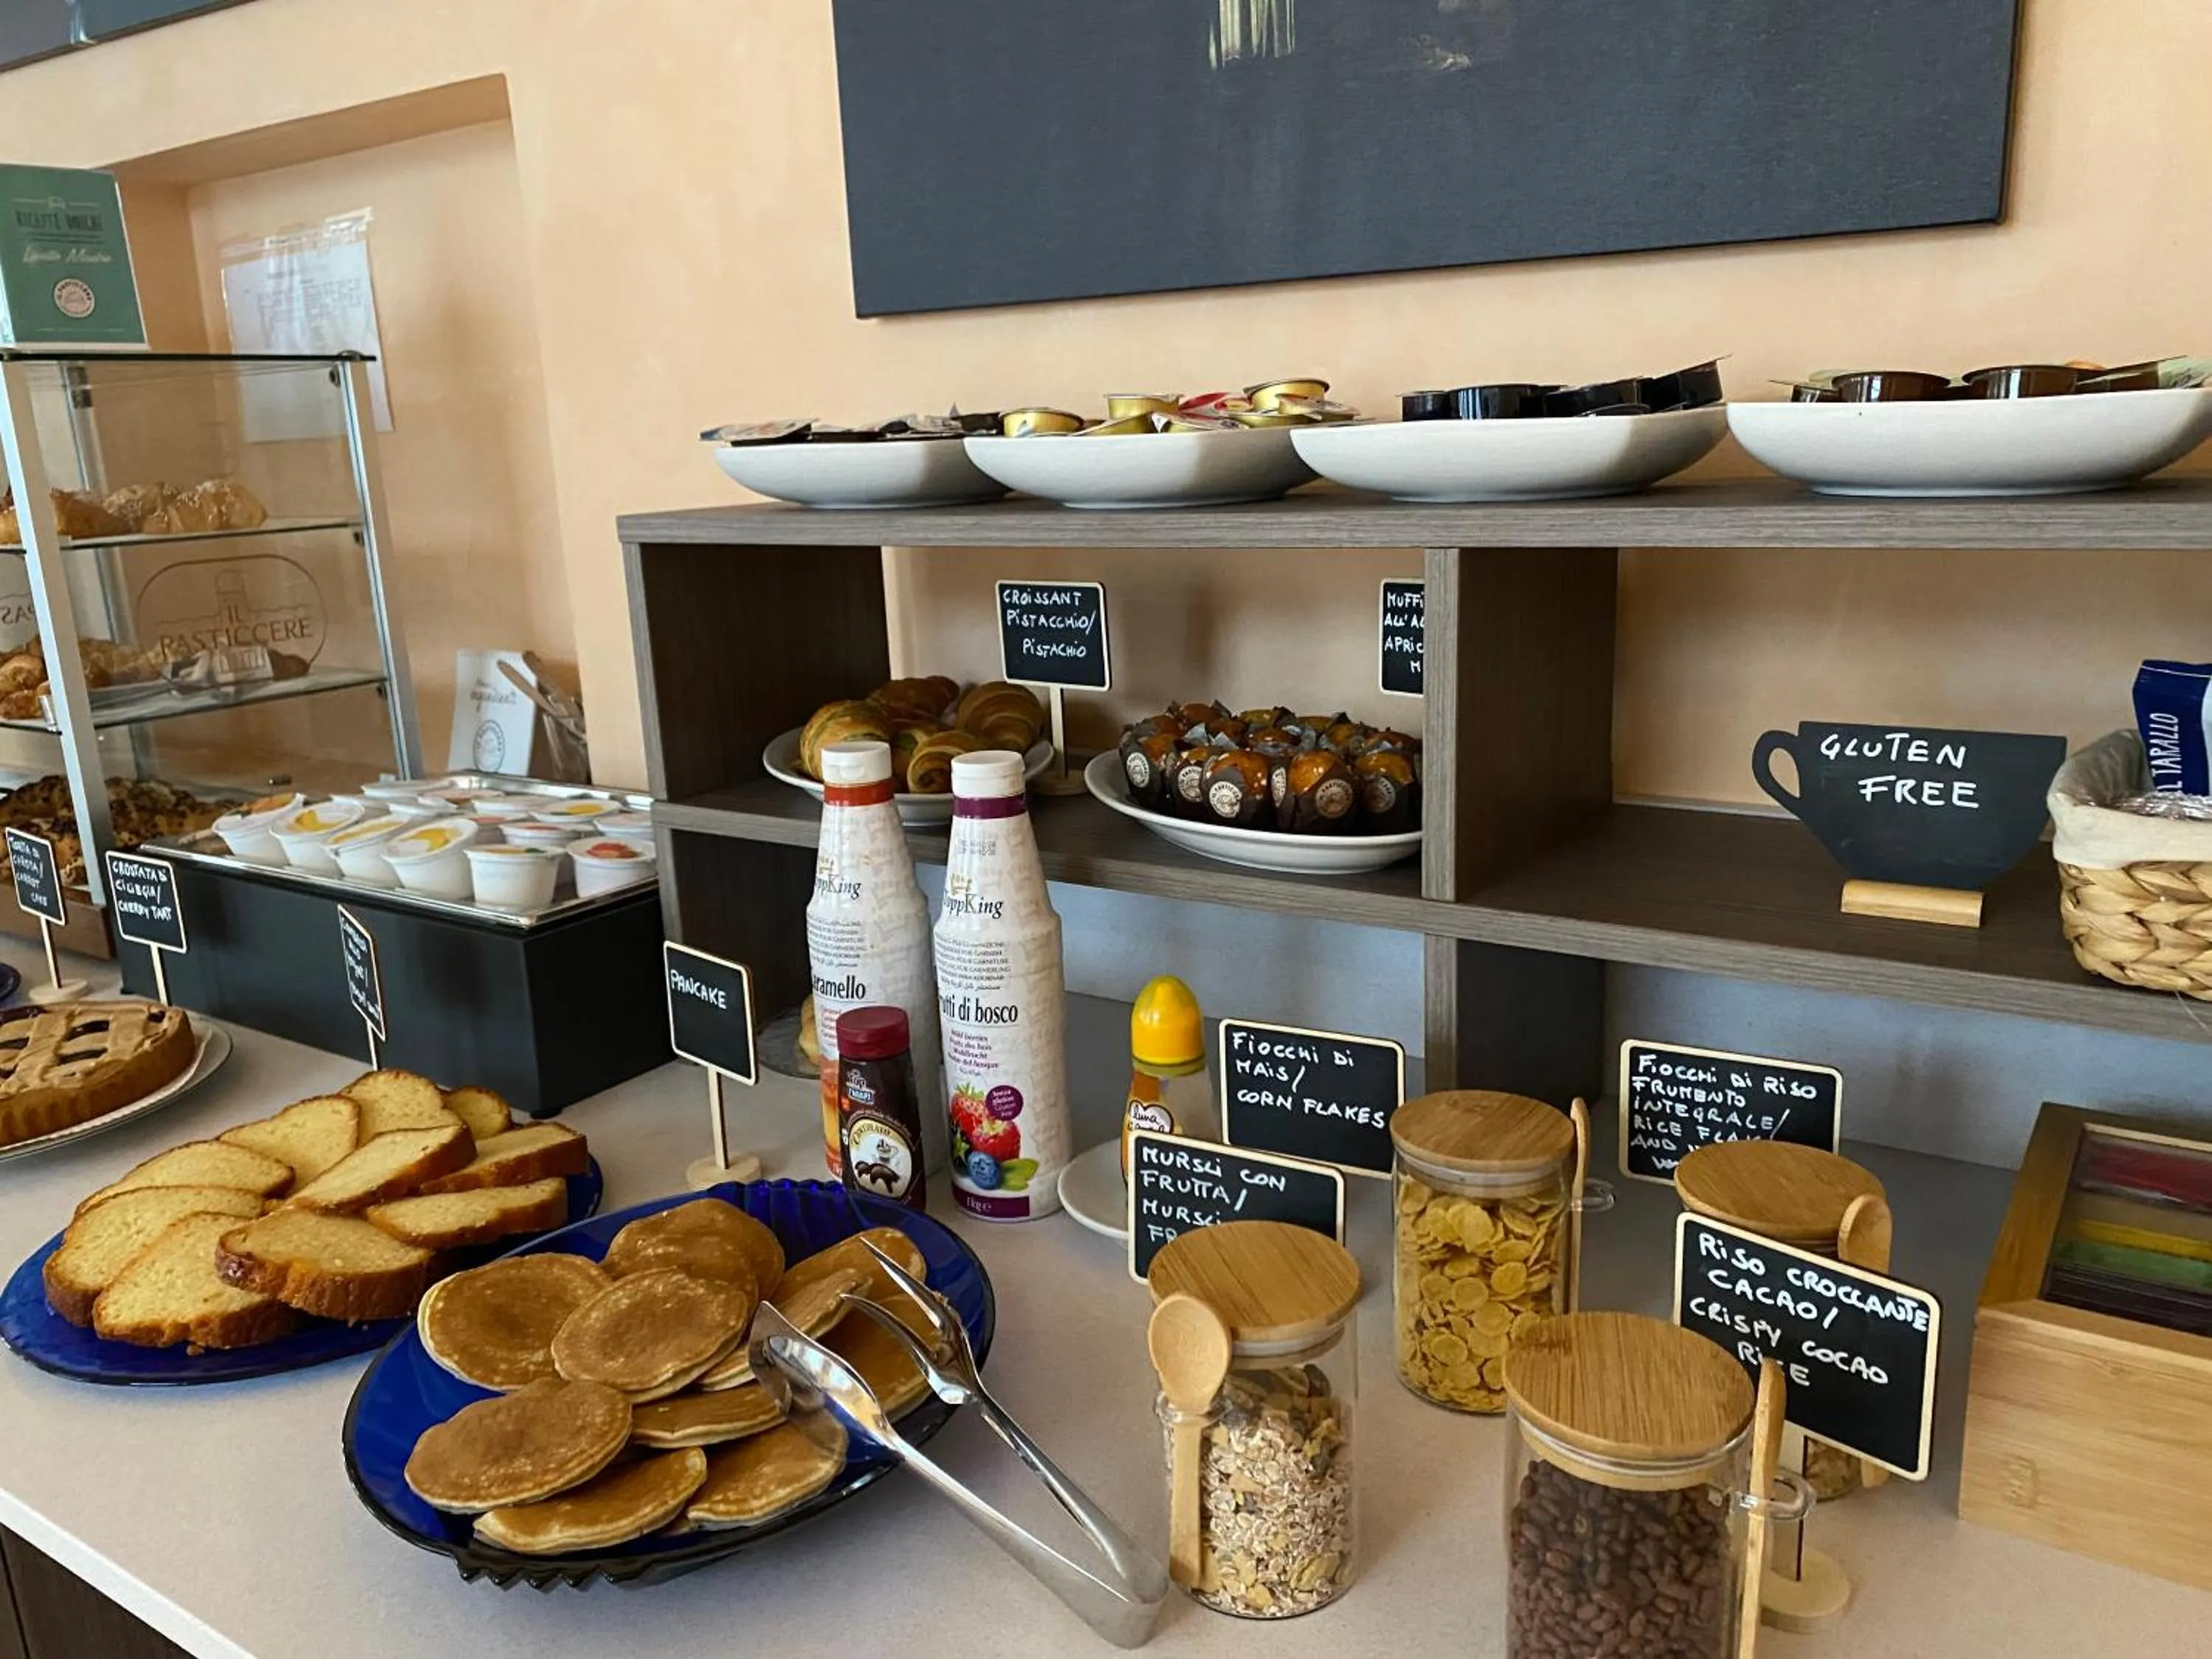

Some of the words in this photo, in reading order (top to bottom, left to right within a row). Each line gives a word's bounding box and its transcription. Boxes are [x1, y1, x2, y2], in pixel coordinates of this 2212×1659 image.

[226, 604, 242, 625] IL
[1387, 591, 1425, 608] MUFFI
[1023, 638, 1086, 658] PISTACHIO
[1384, 636, 1425, 654] APRIC
[1820, 732, 1966, 769] GLUTEN
[2149, 712, 2183, 777] TARALLO
[1857, 775, 1979, 809] FREE
[814, 874, 862, 900] ppKing
[944, 889, 1004, 919] oppKing
[670, 969, 726, 1009] PANCAKE
[813, 974, 866, 999] ramello
[959, 996, 970, 1022] di
[975, 998, 1018, 1023] bosco
[1231, 1032, 1320, 1063] FIOCCHI
[1333, 1050, 1354, 1068] DI
[1632, 1076, 1747, 1107] FRUMENTO
[1638, 1054, 1717, 1083] FIOCCHI
[1731, 1072, 1753, 1088] DI
[1763, 1076, 1818, 1100] RISO
[1237, 1088, 1293, 1110] CORN
[1303, 1098, 1386, 1130] FLAKES
[1633, 1114, 1683, 1137] RICE
[1630, 1133, 1677, 1151] AND
[1239, 1169, 1287, 1192] CON
[1699, 1232, 1766, 1276] RISO
[1787, 1267, 1930, 1332] CROCCANTE
[1737, 1340, 1810, 1387] RIE
[1801, 1340, 1888, 1385] COCAO
